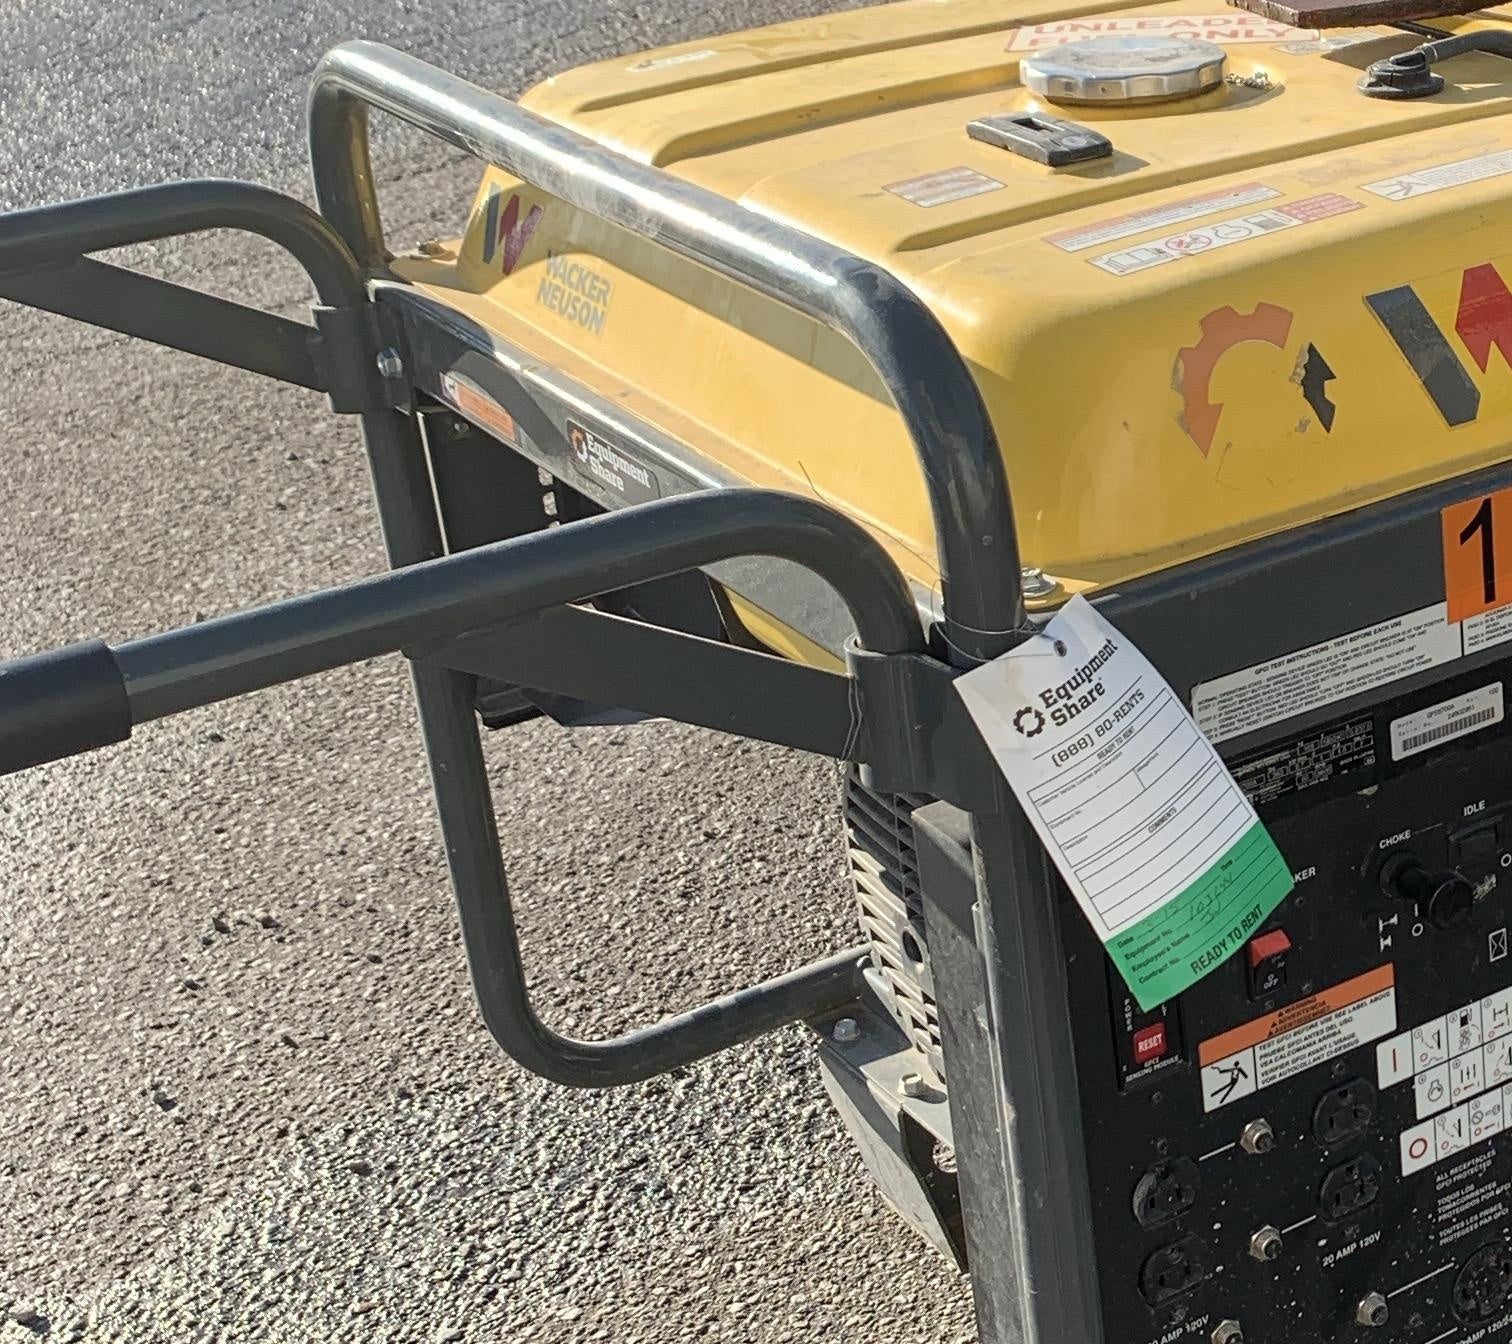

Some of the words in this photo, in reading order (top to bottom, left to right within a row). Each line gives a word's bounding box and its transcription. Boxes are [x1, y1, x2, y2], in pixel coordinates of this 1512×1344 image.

[1033, 16, 1277, 35] UNLEADE
[1168, 28, 1291, 41] ONLY
[546, 250, 612, 307] WACKER
[536, 277, 607, 337] NEUSON
[586, 432, 651, 489] Equipment
[589, 457, 625, 492] Share
[1038, 637, 1119, 710] Equipment
[1050, 681, 1106, 727] Share
[1052, 733, 1095, 768] (888)
[1094, 688, 1146, 738] 80-RENTS
[1096, 741, 1118, 760] READY
[1115, 735, 1124, 747] TO
[1121, 725, 1137, 743] RENT
[1147, 806, 1177, 834] COMMENTS
[1463, 799, 1486, 817] IDLE
[1379, 829, 1412, 849] CHOKE
[1189, 939, 1229, 975] READY
[1227, 926, 1242, 944] TO
[1240, 903, 1263, 933] RENT
[1263, 978, 1280, 990] OFF
[1258, 1038, 1274, 1052] TEST
[1292, 1020, 1318, 1038] BEFORE
[1319, 1014, 1332, 1026] USE
[1334, 1008, 1346, 1020] SEE
[1348, 999, 1367, 1014] LABEL
[1369, 990, 1390, 1005] ABOVE
[1303, 1027, 1324, 1042] ANTES
[1325, 1021, 1338, 1033] DEL
[1137, 1032, 1163, 1053] RESET
[1259, 1057, 1272, 1069] VEA
[1321, 1253, 1335, 1268] 20
[1335, 1242, 1357, 1262] AMP
[1358, 1230, 1382, 1250] 120V
[1184, 1313, 1210, 1335] 120V
